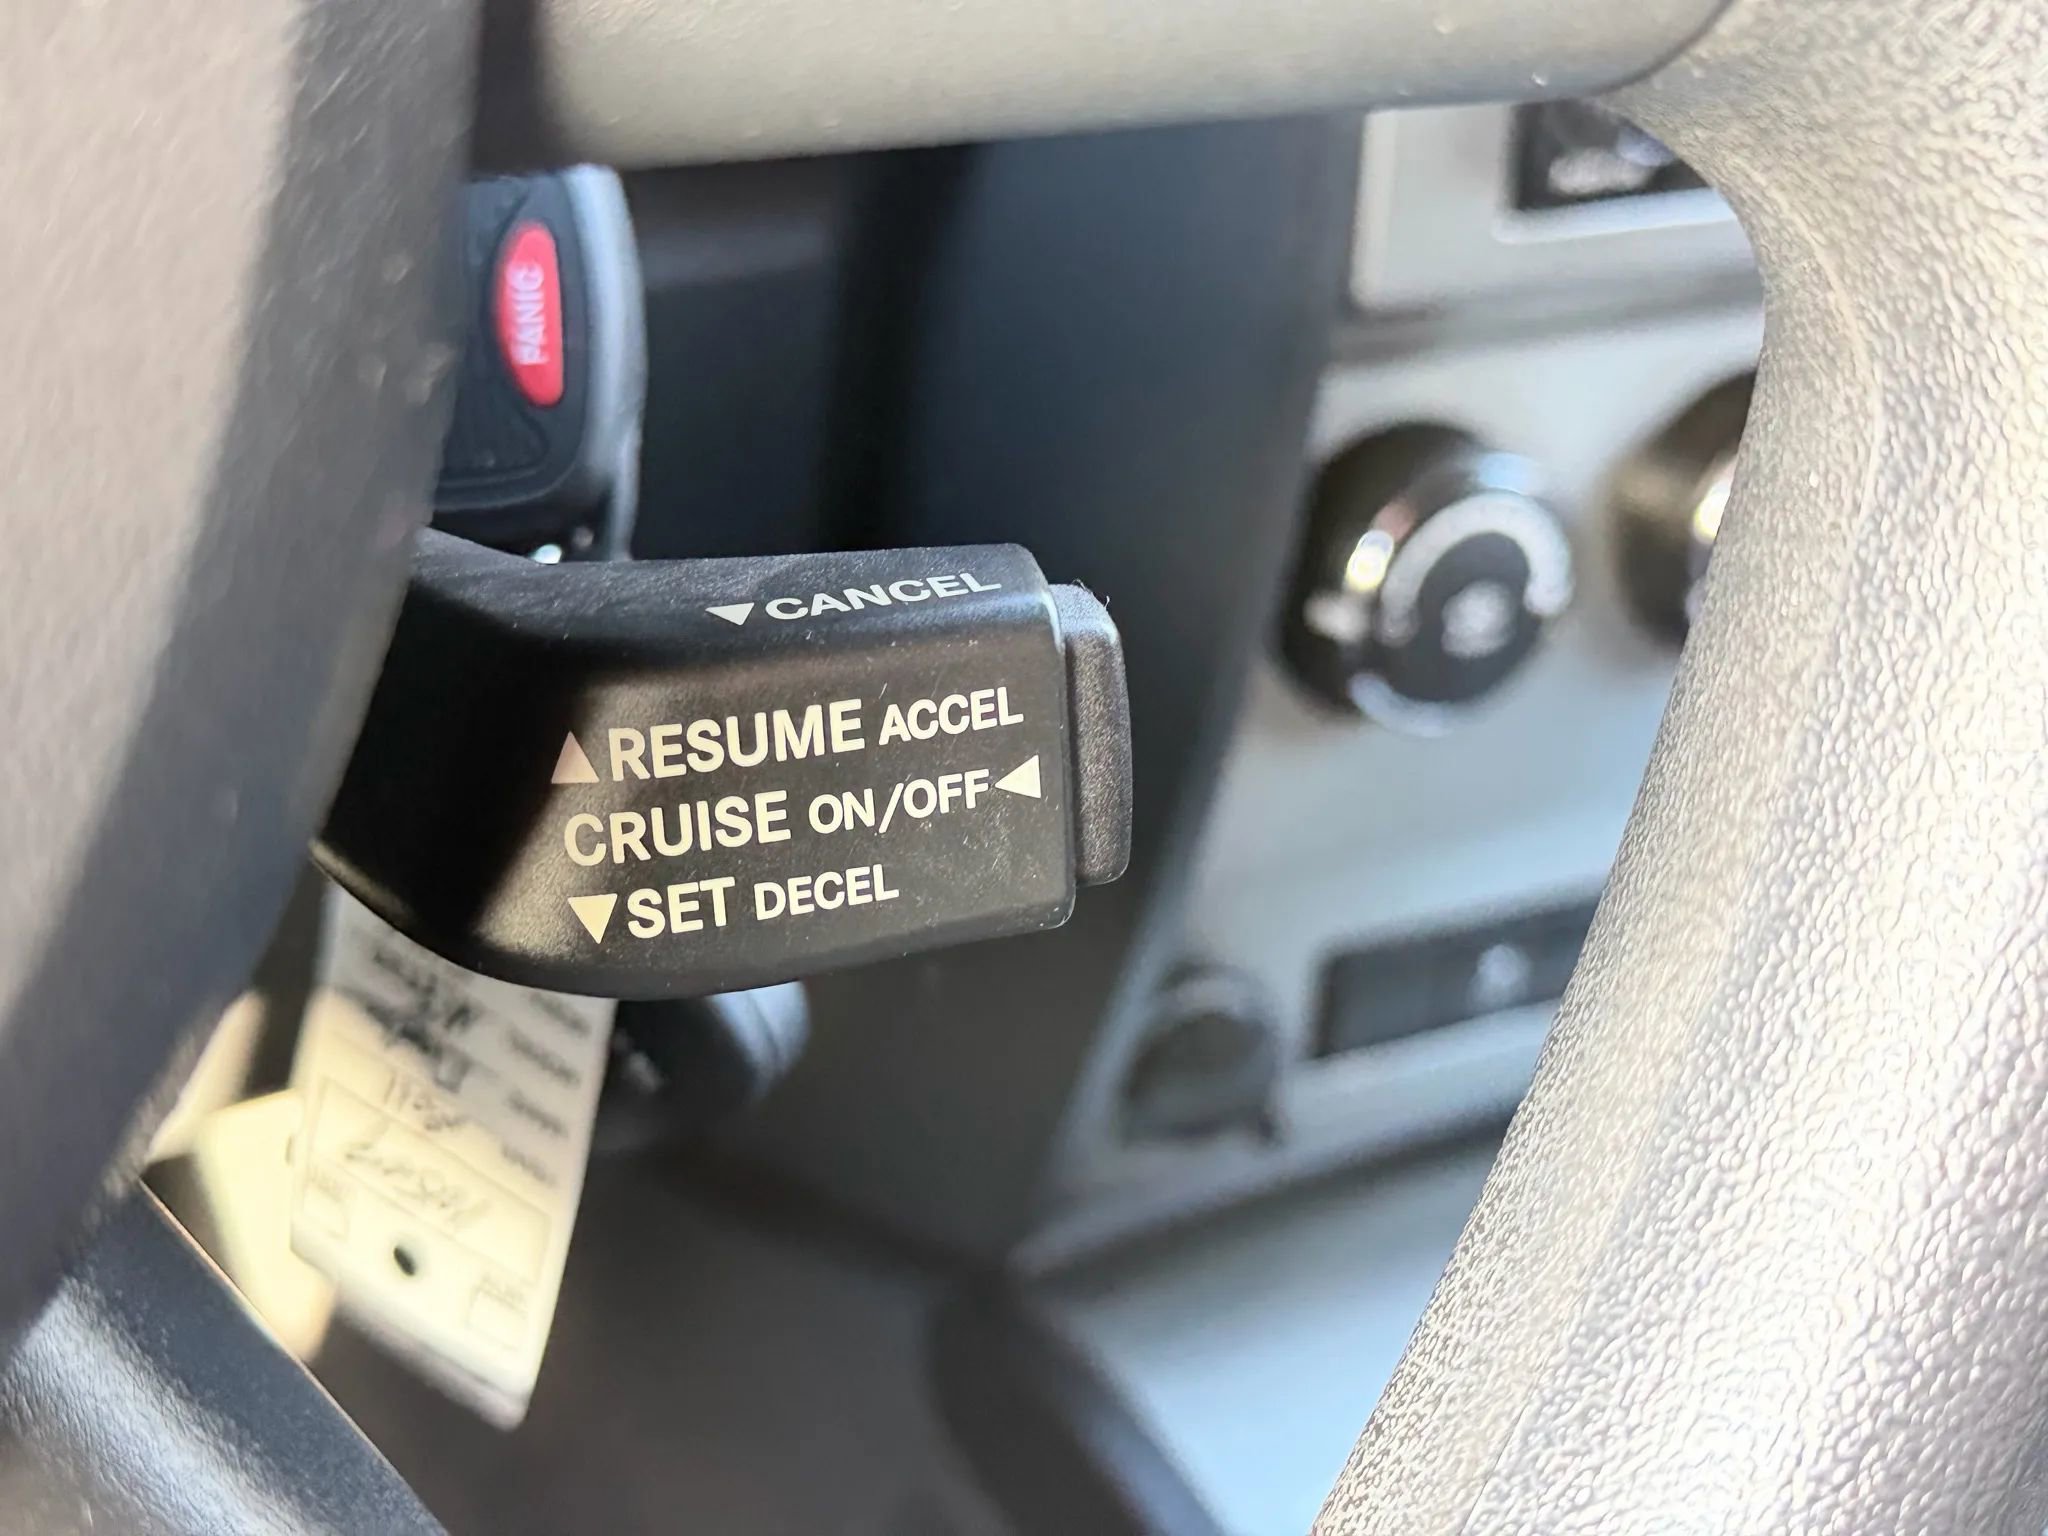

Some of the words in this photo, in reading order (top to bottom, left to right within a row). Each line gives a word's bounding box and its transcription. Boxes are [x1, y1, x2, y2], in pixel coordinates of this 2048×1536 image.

[506, 260, 550, 366] PANIC
[764, 571, 1001, 621] CANCEL
[608, 699, 865, 781] RESUME
[878, 686, 1024, 746] ACCEL
[563, 790, 791, 866] CRUISE
[808, 768, 990, 834] ON/OFF
[627, 876, 735, 939] SET
[754, 863, 899, 920] DECEL
